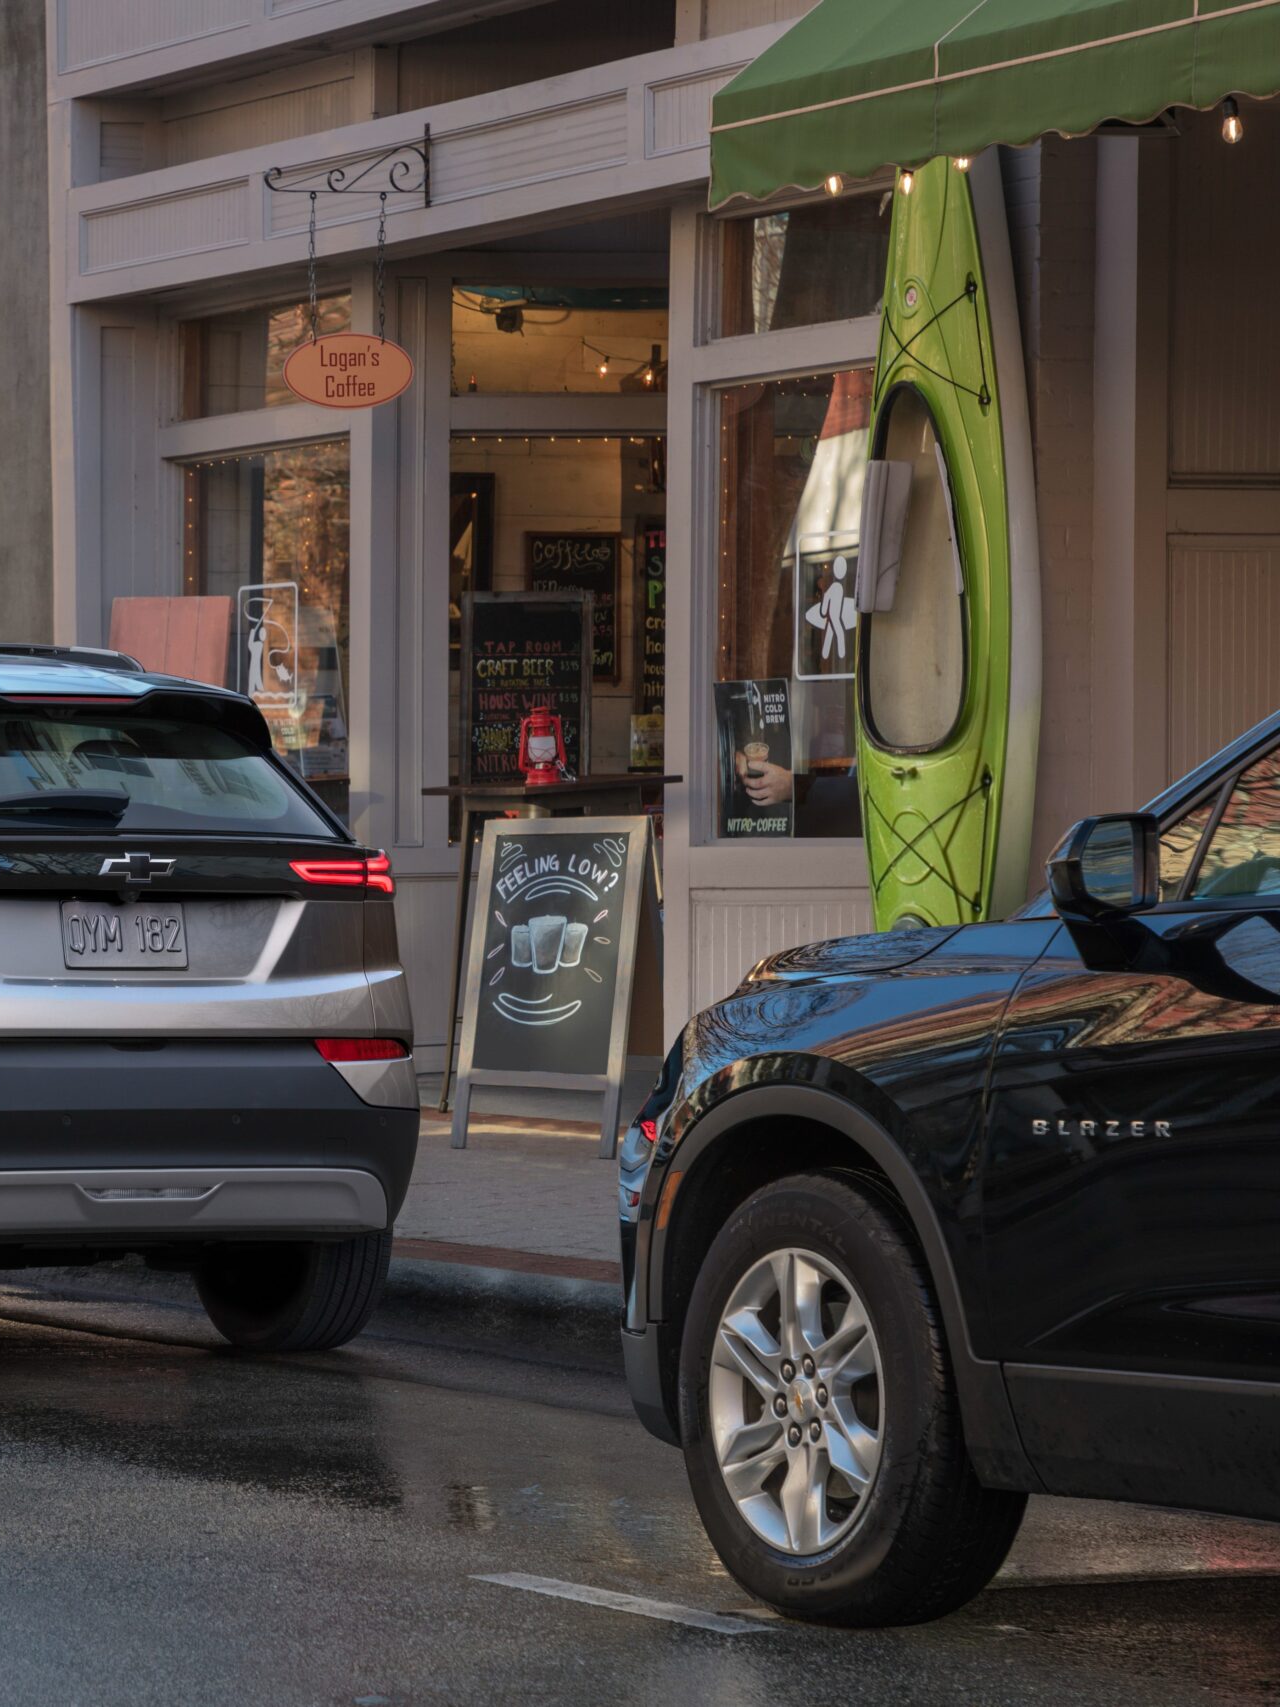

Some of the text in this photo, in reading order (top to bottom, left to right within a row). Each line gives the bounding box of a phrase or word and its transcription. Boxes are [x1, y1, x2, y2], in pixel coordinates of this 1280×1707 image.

[320, 345, 380, 372] Logan's
[325, 375, 376, 398] Coffee
[484, 640, 562, 653] TAP ROOM
[477, 659, 518, 678] CRAFT
[522, 658, 555, 676] BEER
[478, 692, 519, 711] HOUSE
[521, 691, 559, 711] WINE
[763, 693, 785, 703] NITRO
[765, 704, 783, 713] COLD
[765, 714, 785, 724] BREW
[727, 817, 788, 833] NITRO-COFFEE
[496, 854, 619, 899] FEELING LOW?
[68, 914, 183, 955] QYM 182
[1032, 1119, 1172, 1137] BLAZER
